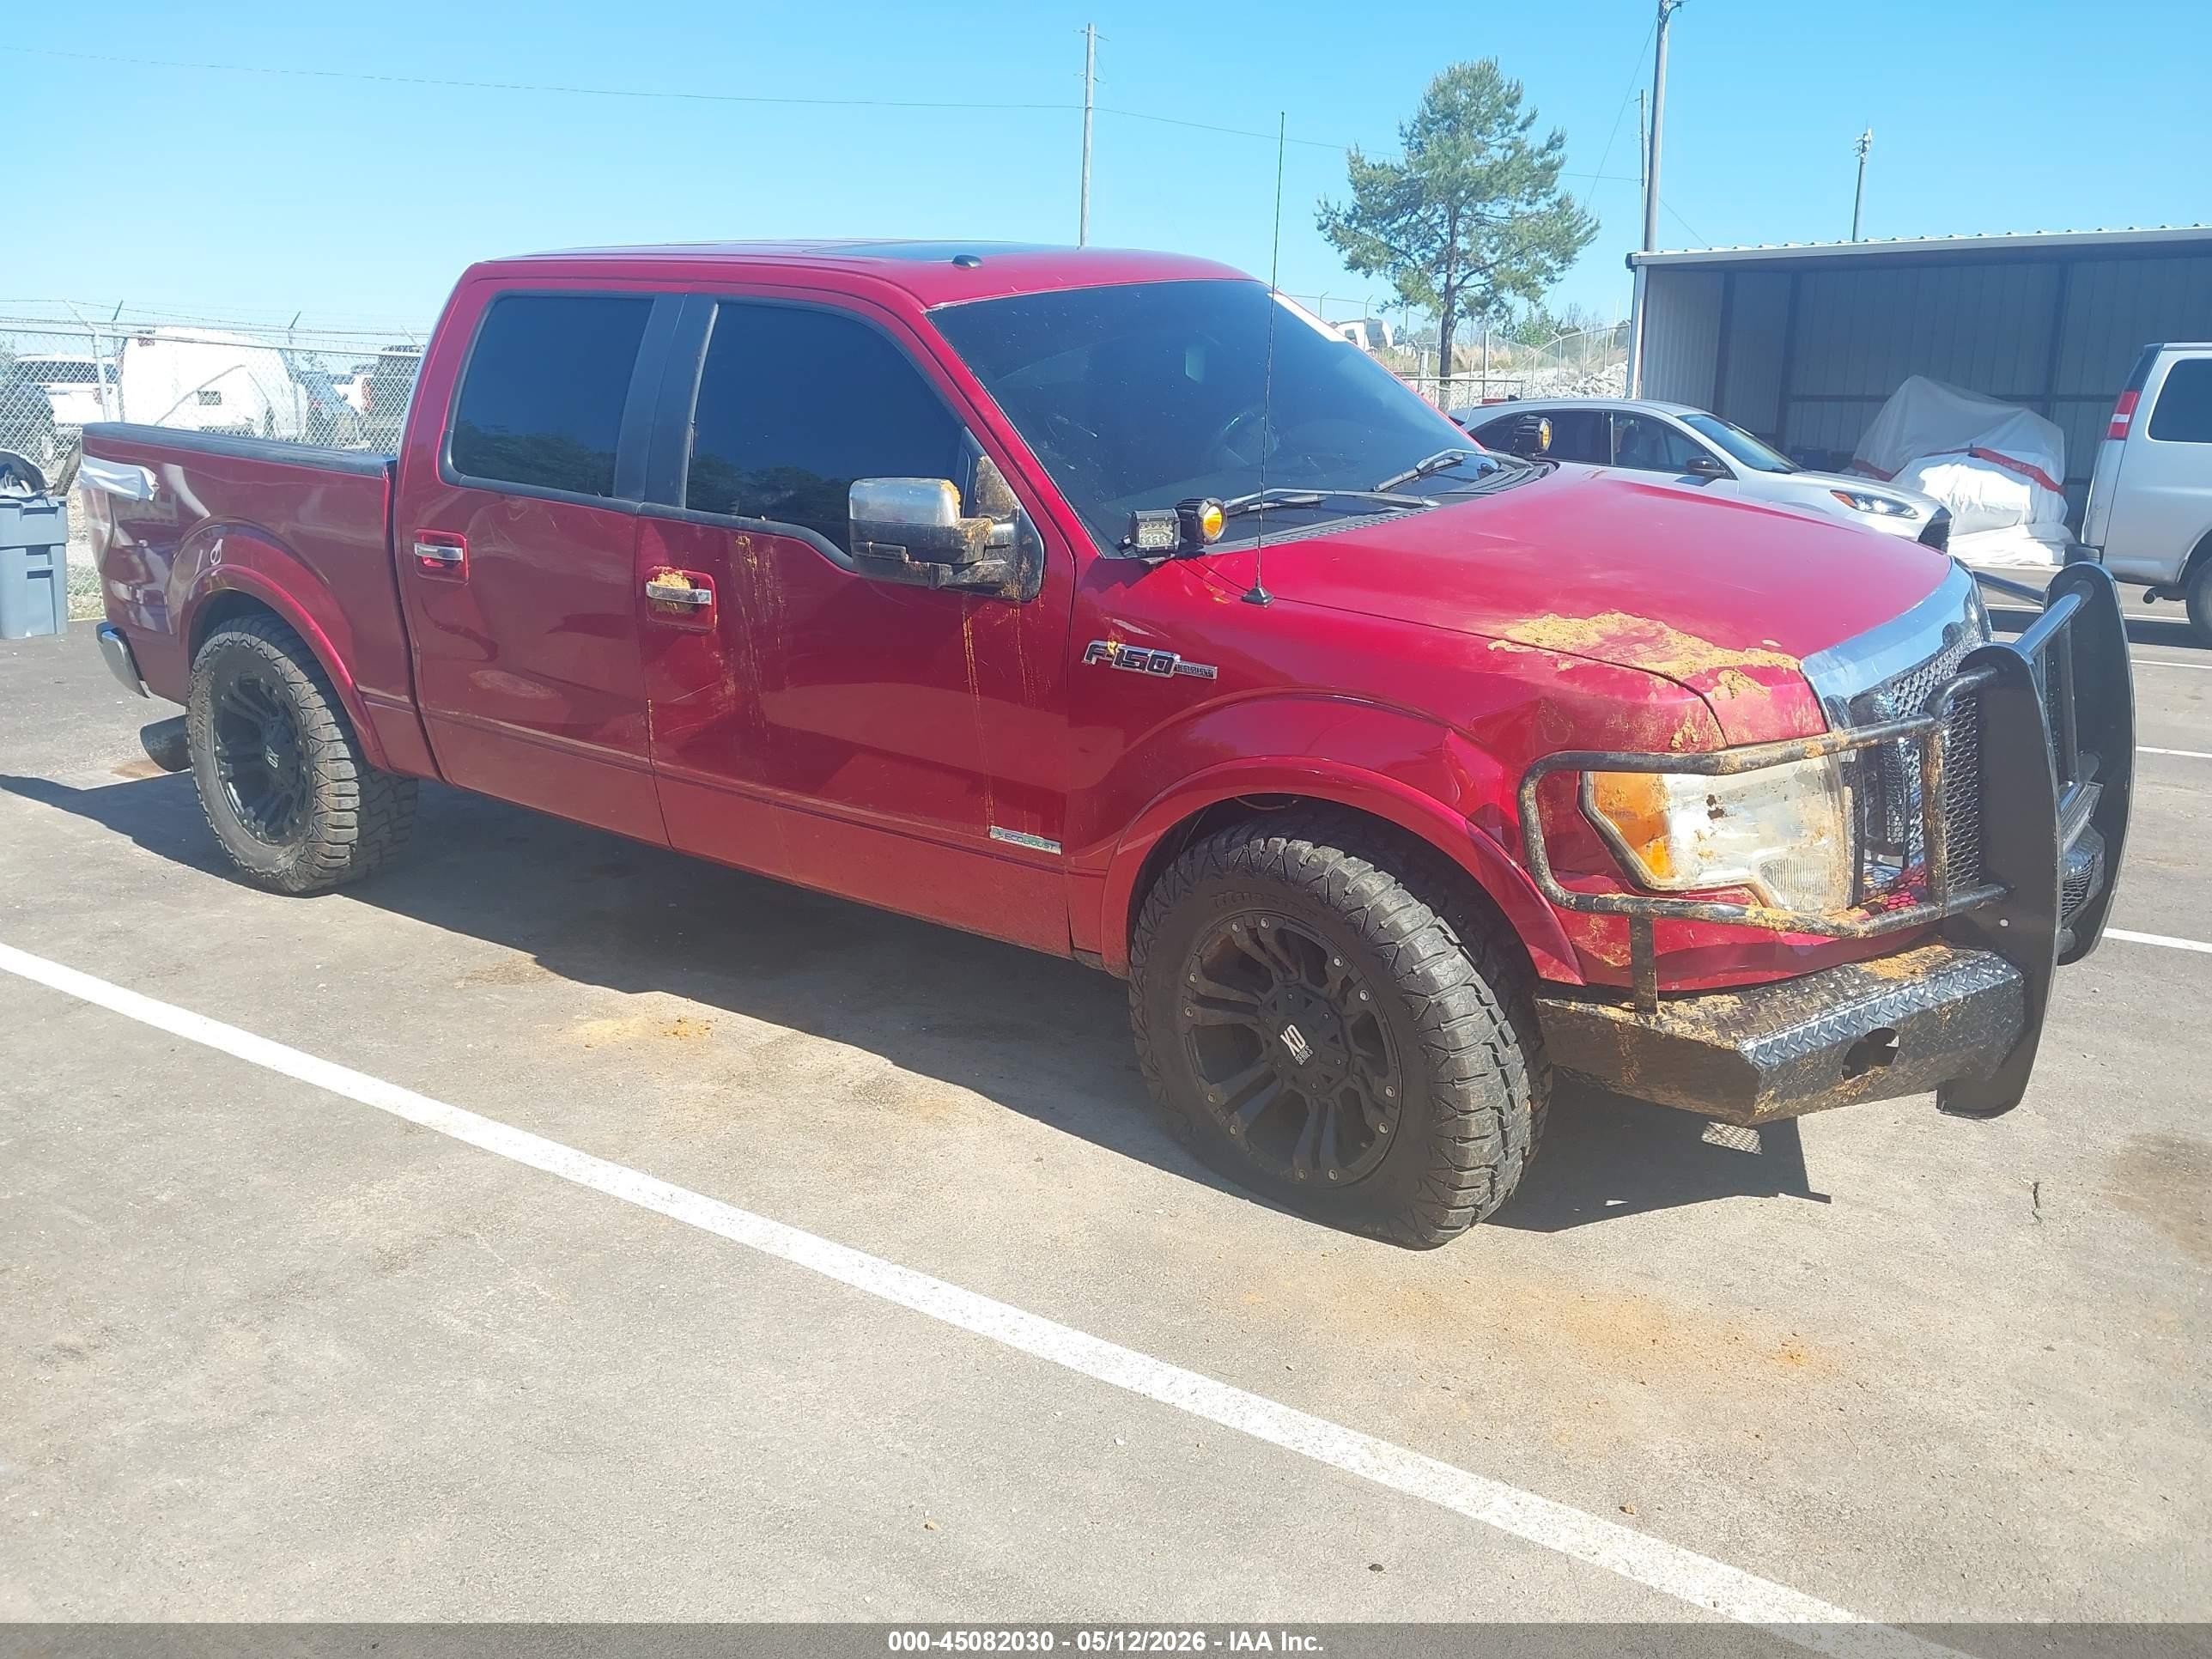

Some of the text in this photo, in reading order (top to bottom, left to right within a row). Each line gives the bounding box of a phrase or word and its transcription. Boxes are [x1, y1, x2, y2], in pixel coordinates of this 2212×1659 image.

[1084, 641, 1179, 678] F-150
[1280, 1024, 1306, 1056] XD
[1295, 1045, 1314, 1065] SERIES
